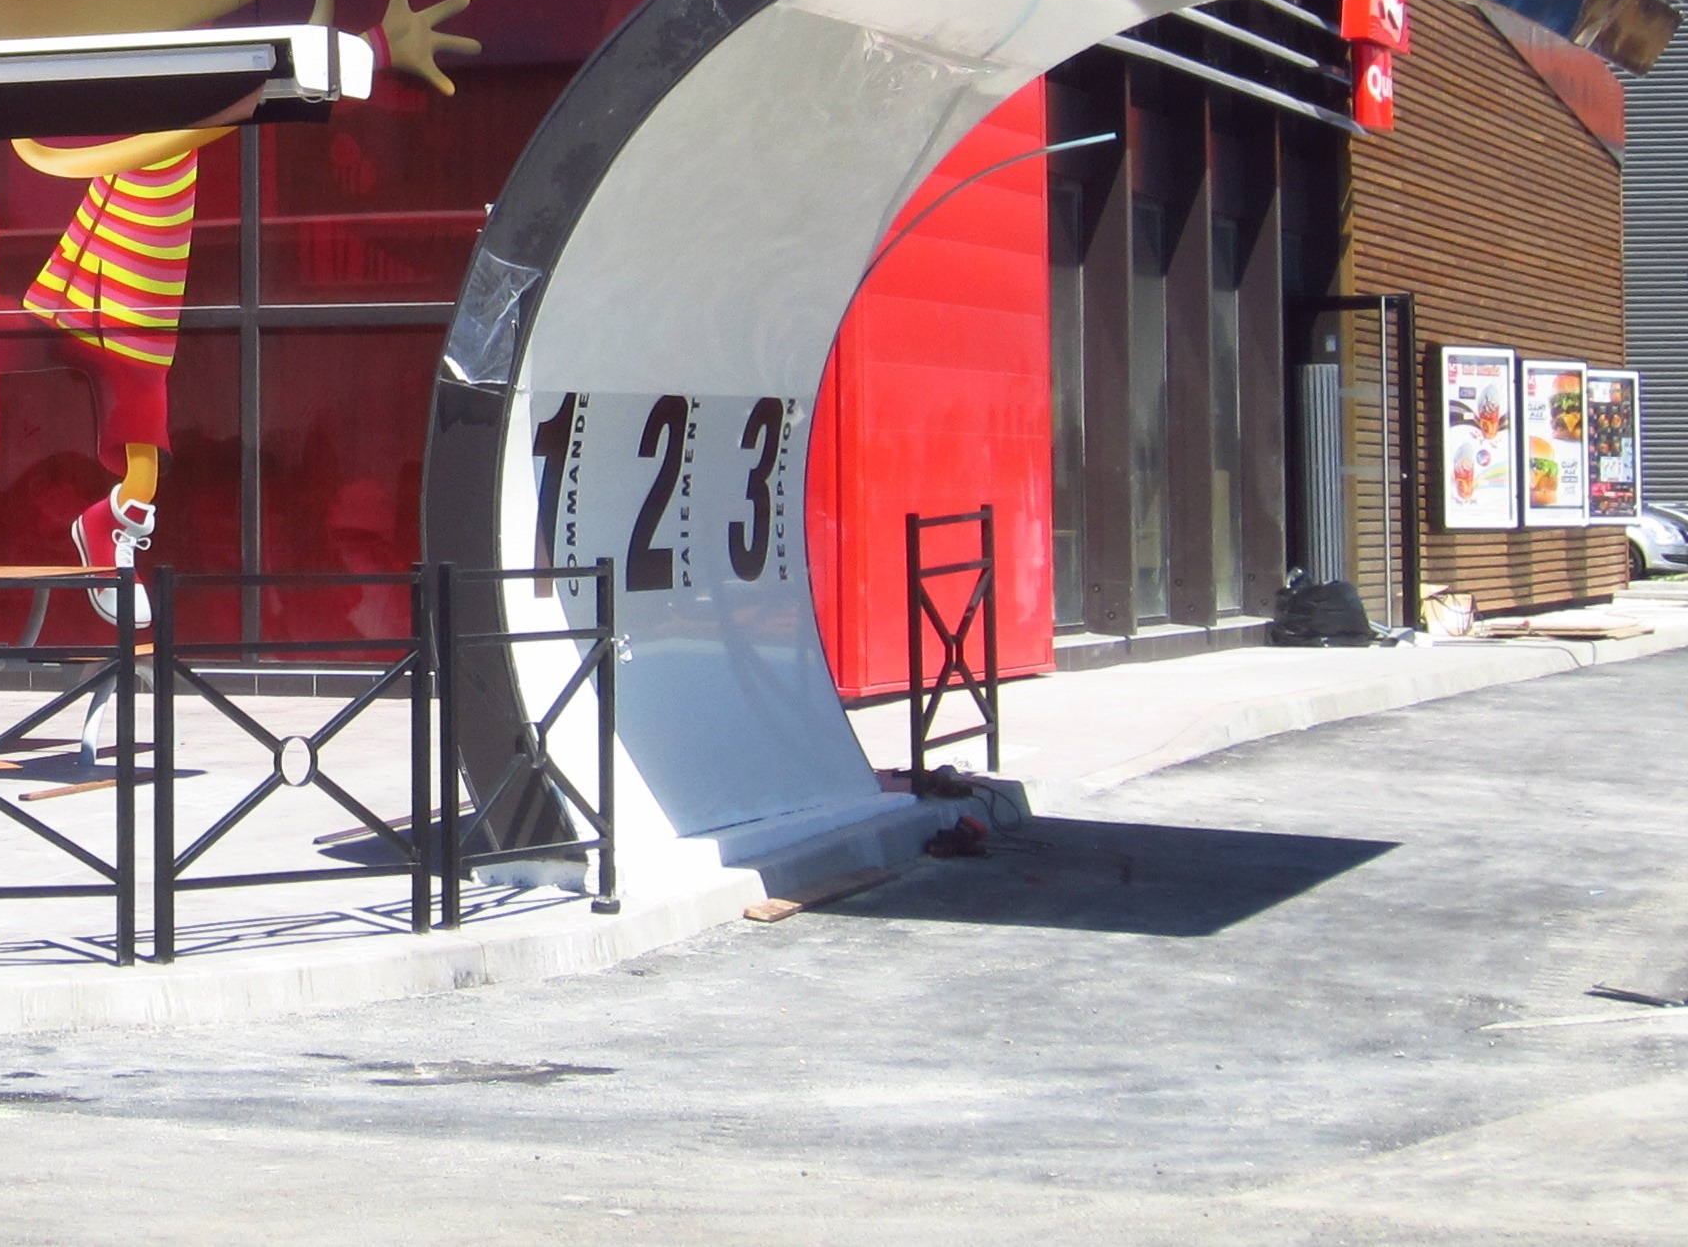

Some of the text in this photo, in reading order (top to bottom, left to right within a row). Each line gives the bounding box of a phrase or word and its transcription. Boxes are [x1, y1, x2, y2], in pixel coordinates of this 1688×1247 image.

[532, 391, 578, 598] 1
[565, 392, 590, 597] COMMANDE
[625, 394, 689, 592] 2
[680, 397, 702, 588] PAIEMENT
[728, 396, 784, 582] 3
[775, 398, 797, 581] RECEPTION
